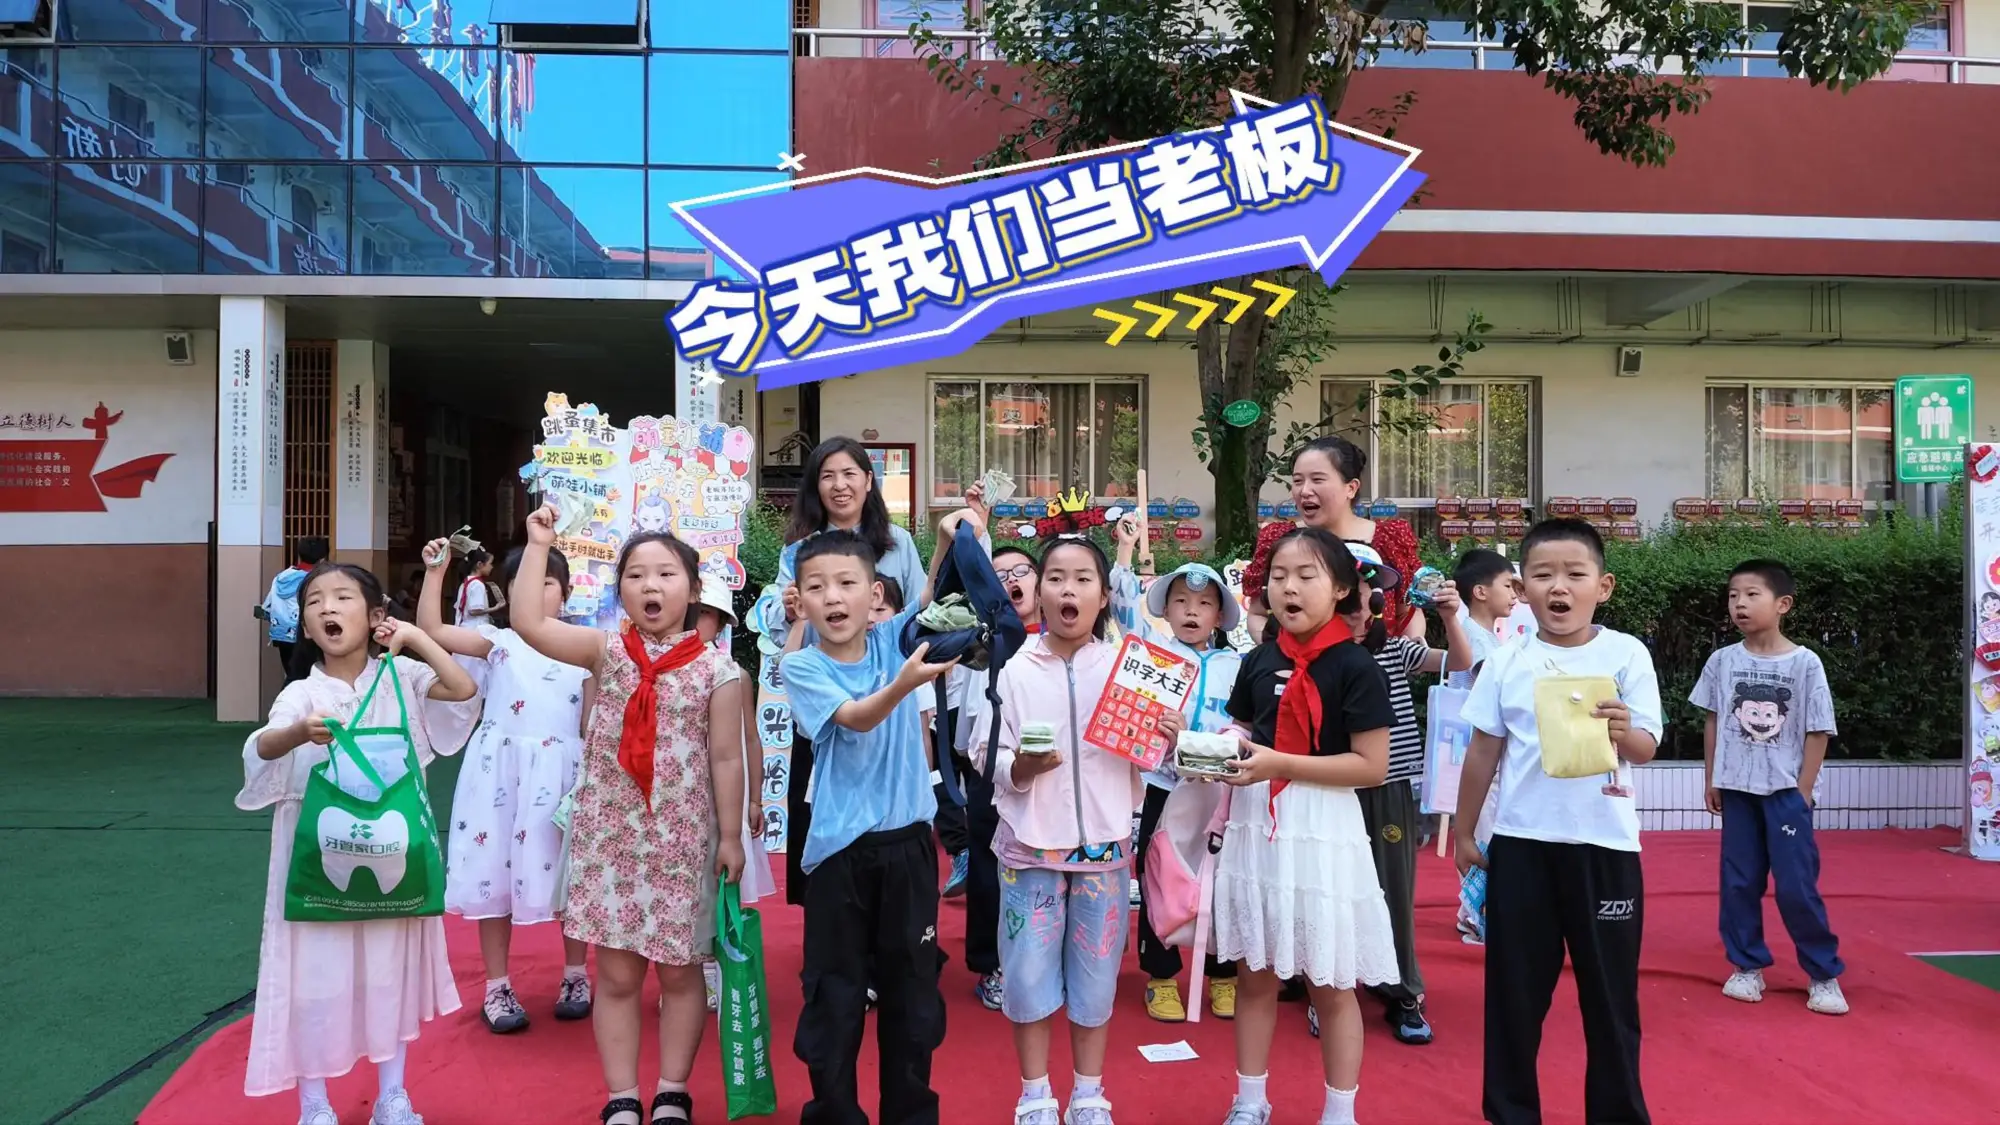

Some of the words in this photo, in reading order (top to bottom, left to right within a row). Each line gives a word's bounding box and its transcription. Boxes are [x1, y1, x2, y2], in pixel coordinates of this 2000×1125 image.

[0, 413, 73, 431] 立德树人
[543, 411, 616, 443] 跳蚤集市
[546, 451, 603, 465] 欢迎光临
[551, 475, 607, 497] 萌娃小铺
[1123, 655, 1187, 697] 识字大王
[325, 836, 400, 854] 牙管家口腔
[1598, 898, 1634, 915] ZDX
[731, 988, 743, 1033] 看牙去
[748, 982, 760, 1029] 牙管家
[732, 1042, 745, 1086] 牙管家
[753, 1035, 767, 1080] 看牙去
